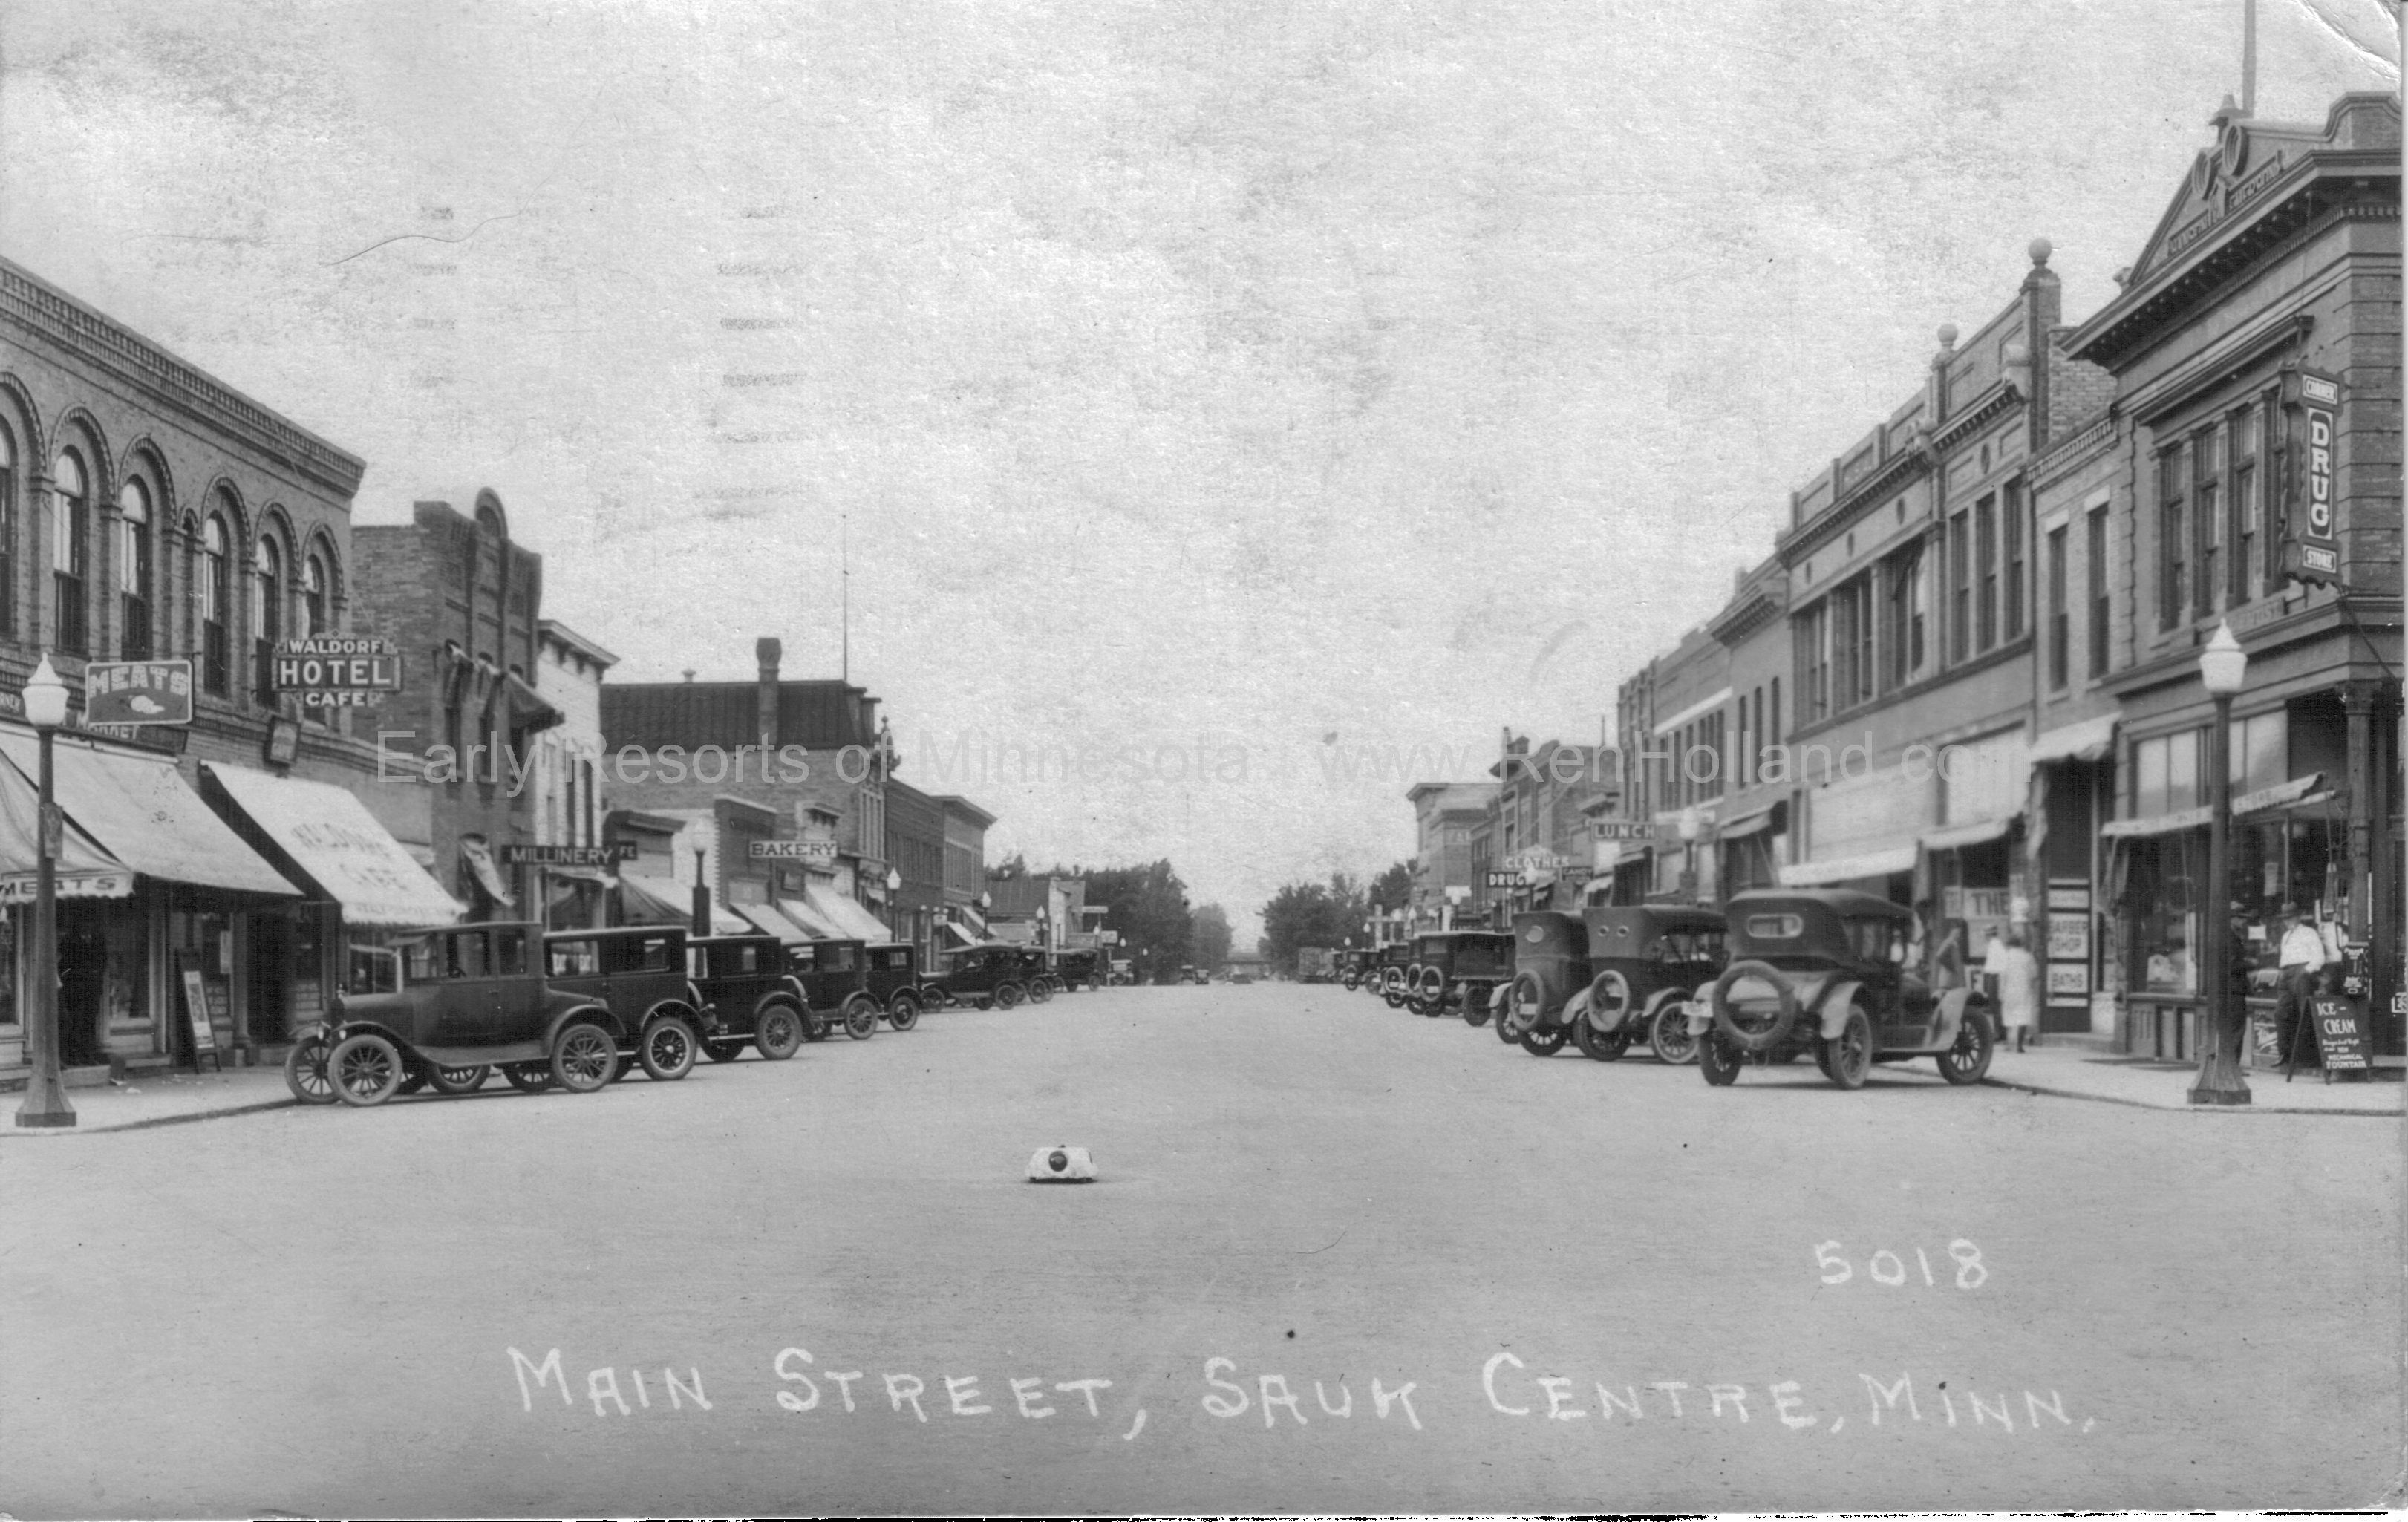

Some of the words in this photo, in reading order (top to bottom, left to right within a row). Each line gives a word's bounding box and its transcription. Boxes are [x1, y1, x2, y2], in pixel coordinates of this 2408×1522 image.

[2310, 420, 2331, 528] DRUG
[2306, 549, 2333, 569] STORE
[288, 639, 382, 654] WALDORF
[279, 659, 391, 685] HOTEL
[88, 664, 189, 698] MEATS
[304, 692, 366, 707] CAFE
[1594, 825, 1655, 838] LUNCH
[510, 846, 613, 865] MILLINERY
[751, 843, 835, 856] BAKERY
[1505, 856, 1570, 869] CLOTHES
[1489, 873, 1524, 886] DRUG
[2316, 1002, 2337, 1016] ICE
[2323, 1019, 2357, 1035] CREAM
[2326, 1060, 2367, 1070] FOUNTAIN
